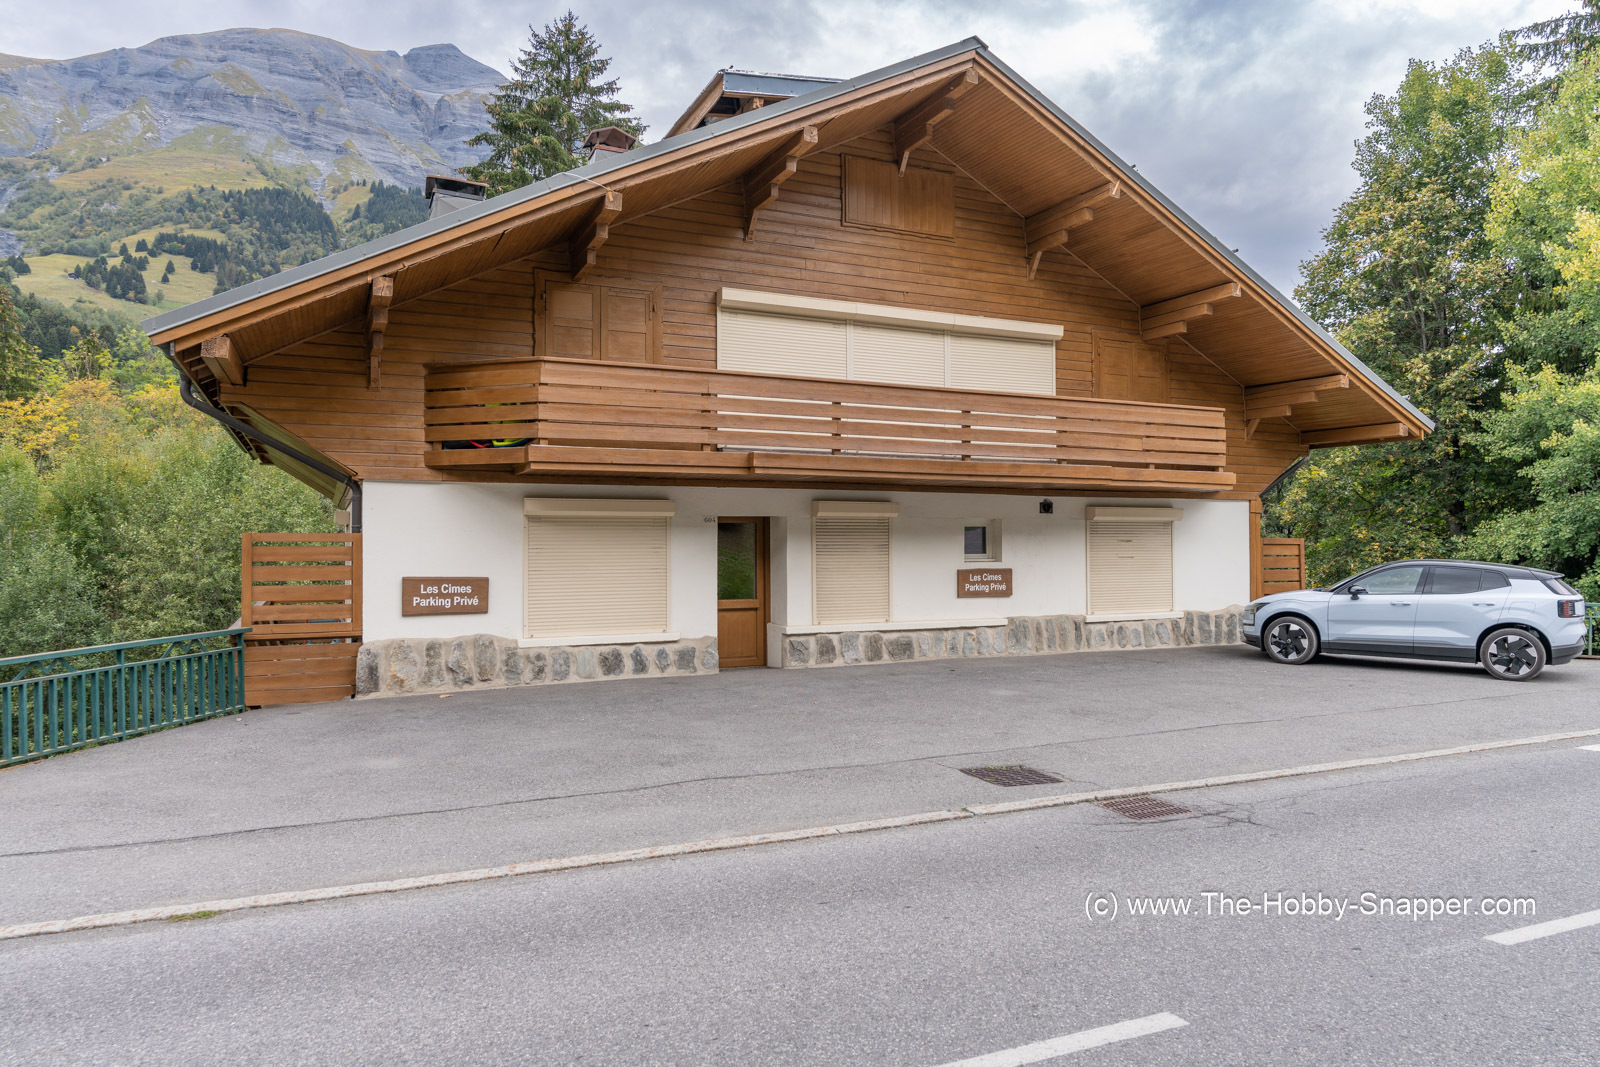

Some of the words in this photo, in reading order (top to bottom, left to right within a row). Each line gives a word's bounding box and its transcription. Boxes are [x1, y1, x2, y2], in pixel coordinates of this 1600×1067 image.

[969, 573, 982, 582] Les
[982, 572, 1002, 581] Cimes
[420, 584, 439, 594] Les
[440, 583, 472, 594] Cimes
[964, 583, 990, 593] Parking
[990, 582, 1007, 591] Privé
[412, 596, 452, 608] Parking
[453, 595, 479, 606] Privé
